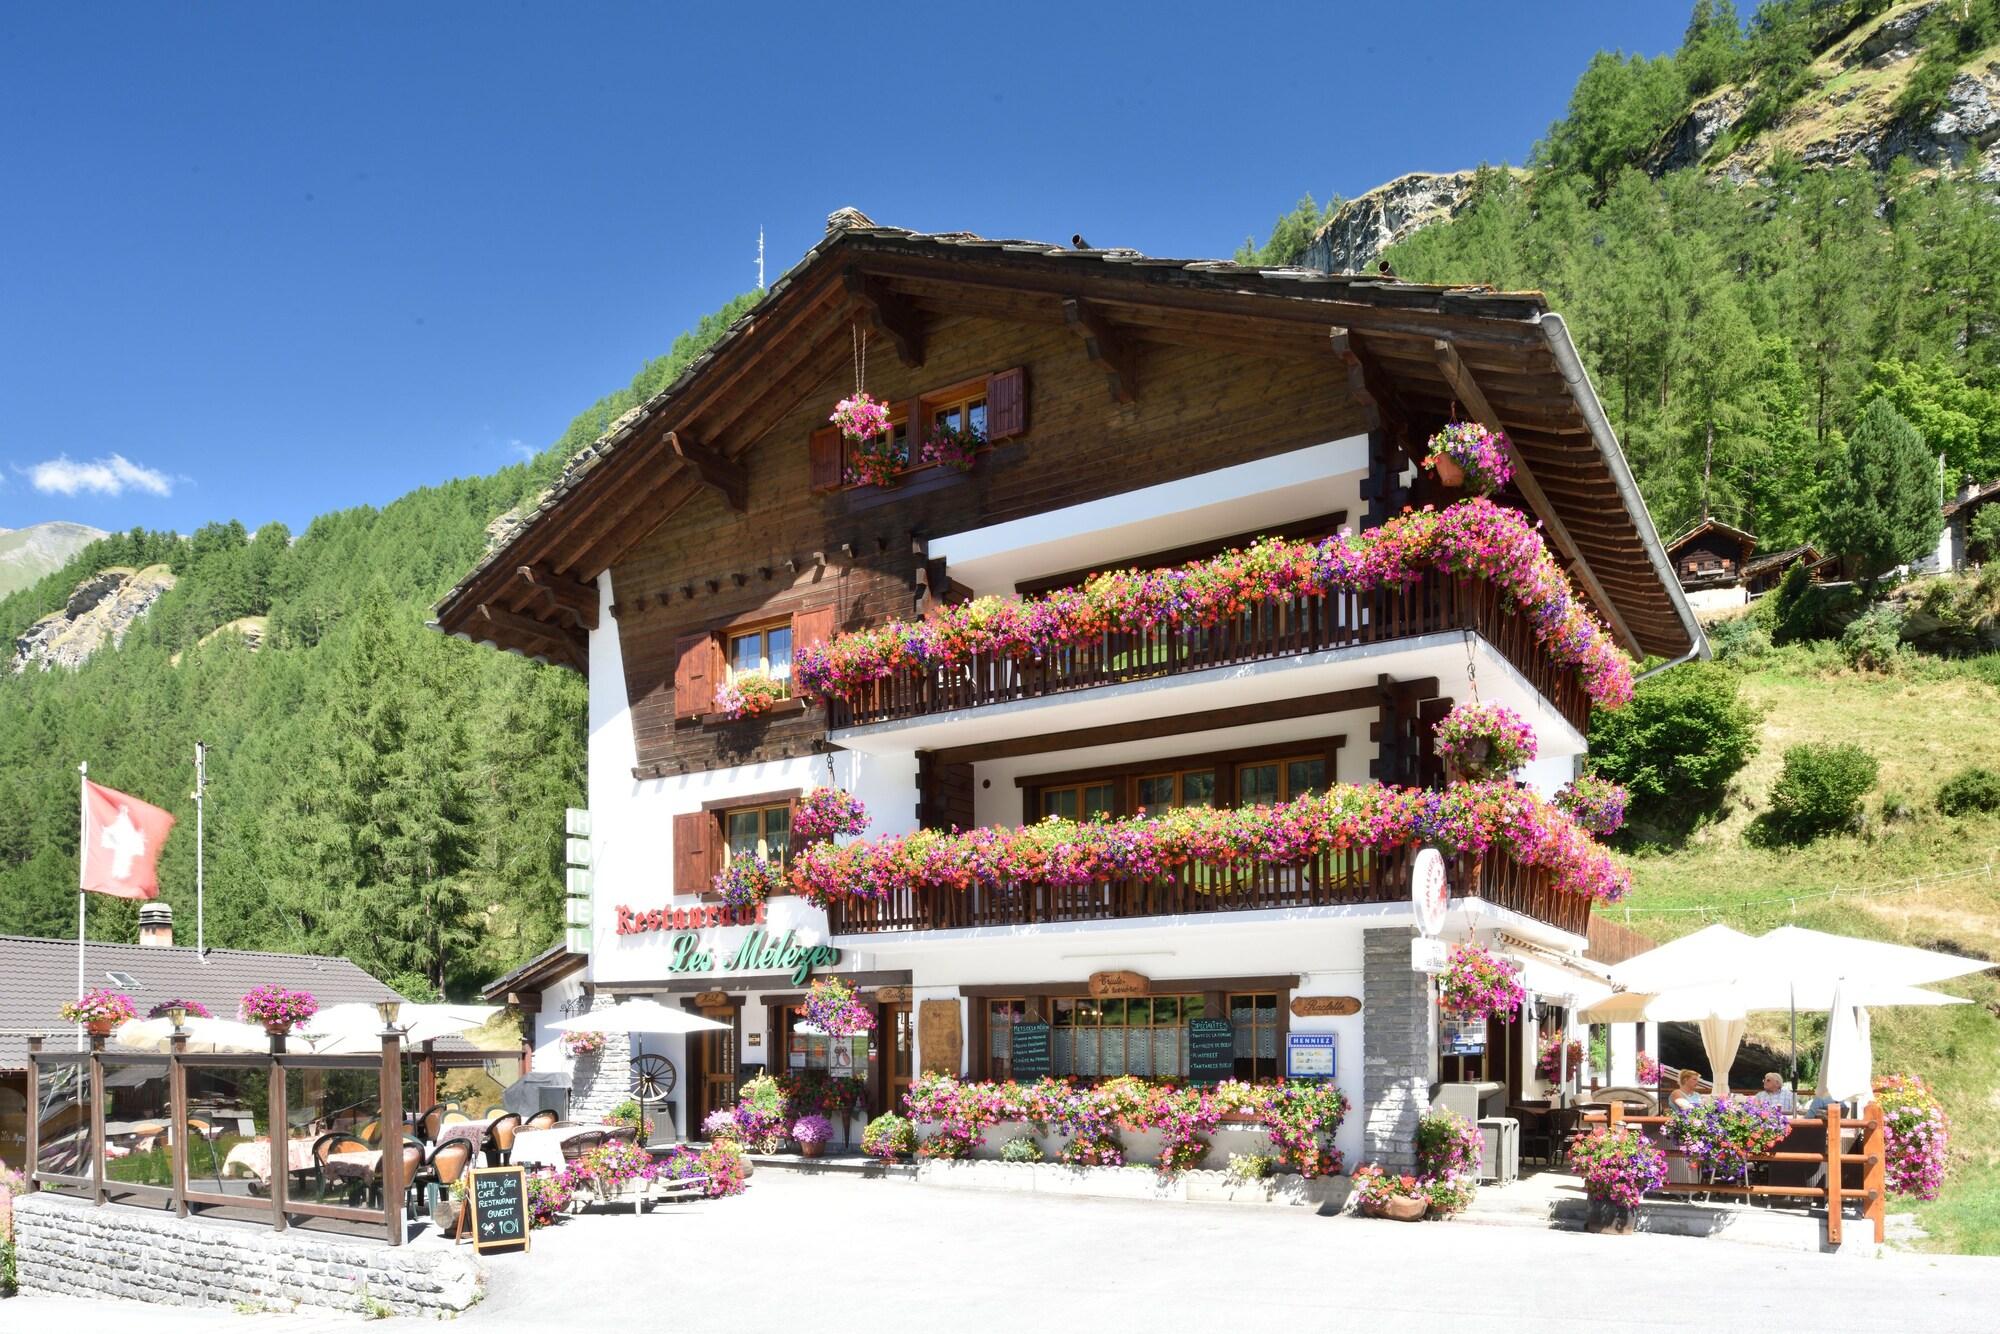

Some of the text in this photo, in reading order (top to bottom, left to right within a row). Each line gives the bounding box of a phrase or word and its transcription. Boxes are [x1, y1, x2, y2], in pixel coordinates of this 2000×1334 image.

[572, 811, 592, 952] HOTEL
[614, 900, 768, 937] Restaurant
[668, 932, 714, 973] Les
[1304, 999, 1346, 1011] Raclette
[500, 1186, 506, 1196] &
[479, 1198, 517, 1208] RESTAURANT
[487, 1208, 514, 1219] OUVERT
